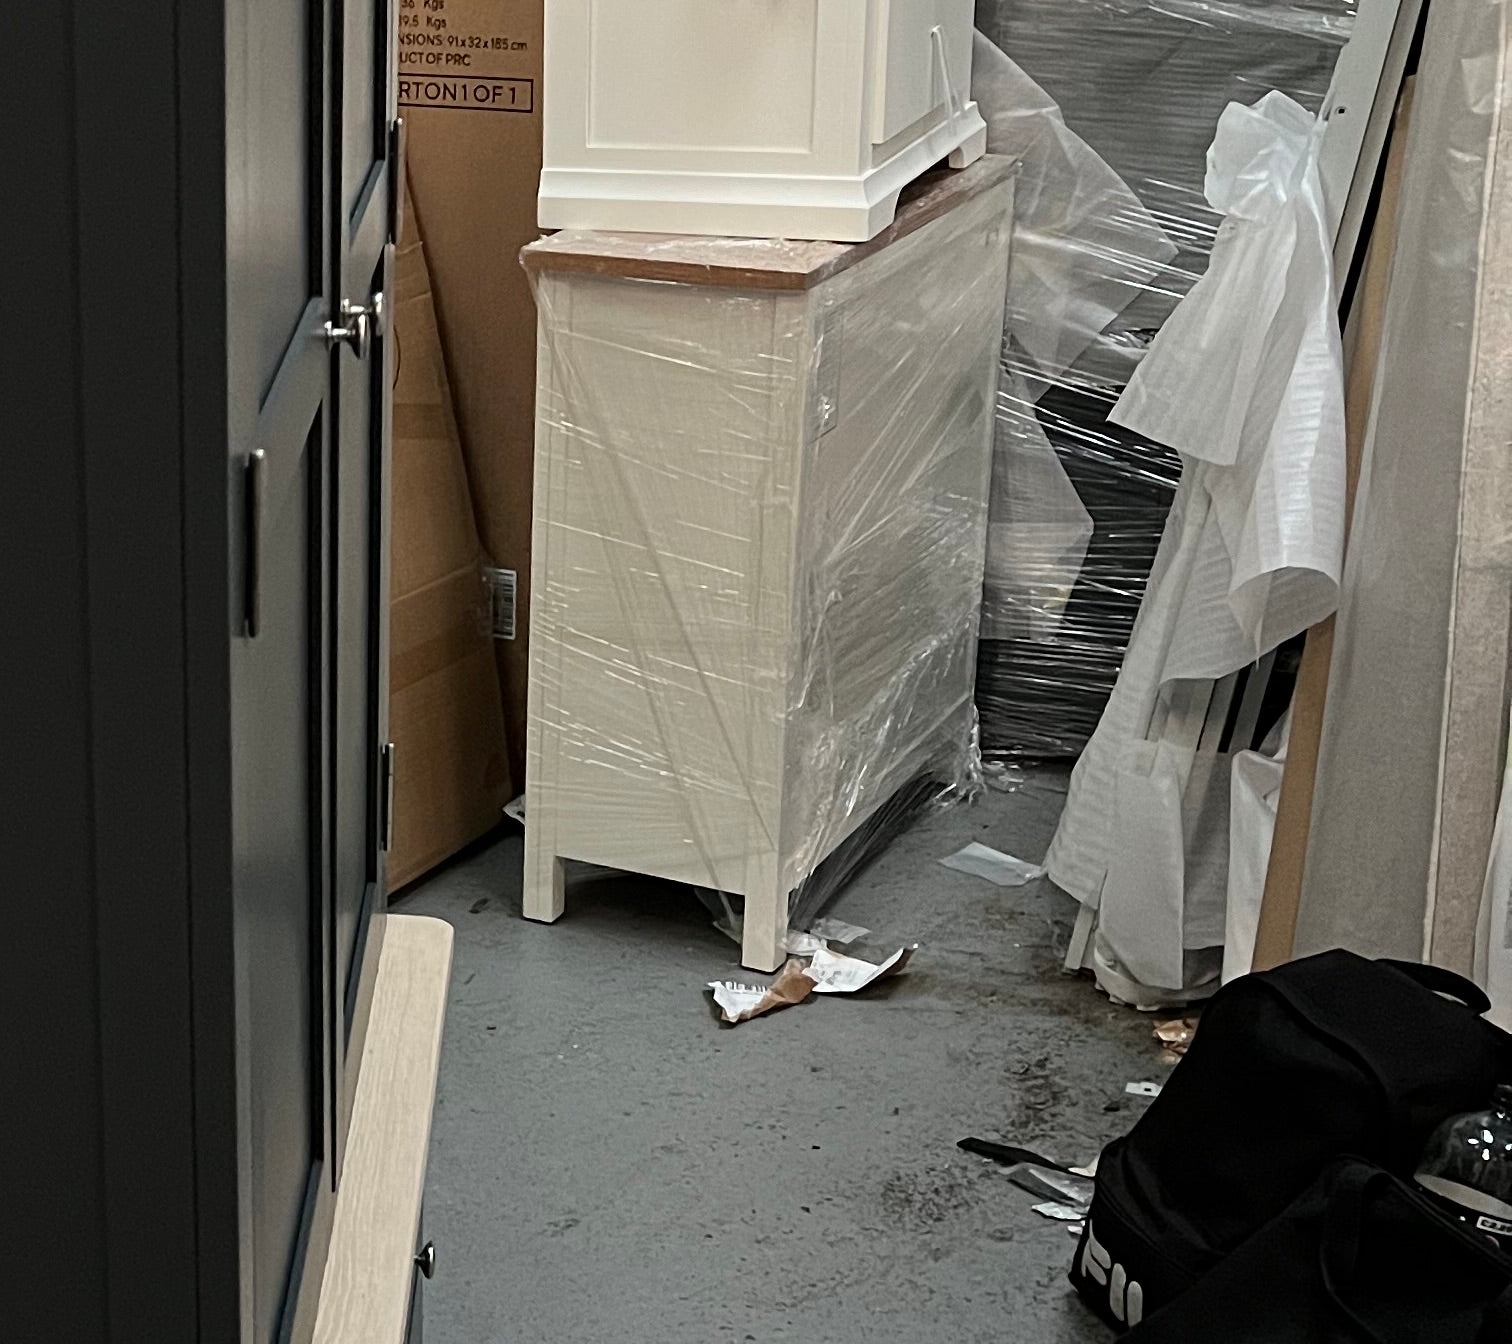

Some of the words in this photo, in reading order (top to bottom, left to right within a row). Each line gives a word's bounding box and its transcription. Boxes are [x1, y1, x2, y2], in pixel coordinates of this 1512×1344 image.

[426, 16, 447, 30] Kgs
[445, 53, 471, 67] PRC
[399, 81, 457, 101] RTON
[473, 84, 503, 104] OF
